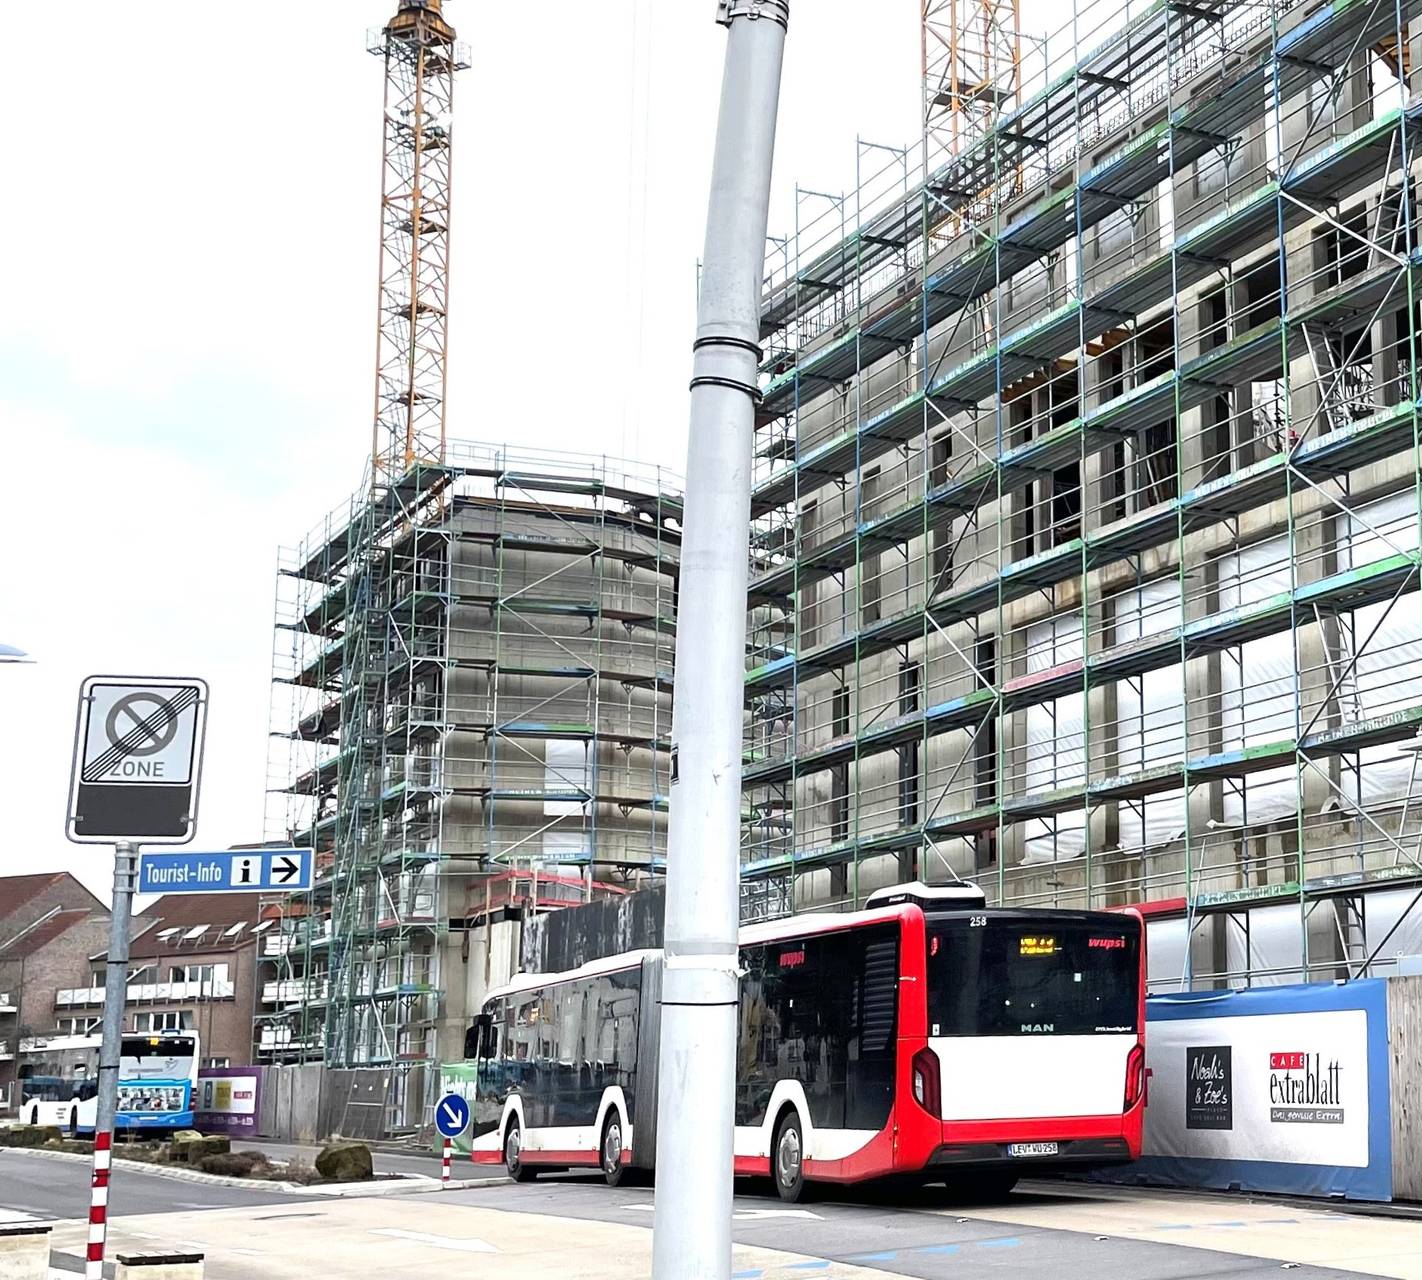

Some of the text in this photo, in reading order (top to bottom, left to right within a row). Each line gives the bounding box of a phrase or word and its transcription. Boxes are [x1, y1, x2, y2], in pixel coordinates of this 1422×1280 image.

[109, 761, 165, 777] ZONE
[146, 861, 222, 884] Tourist-Info
[969, 916, 987, 927] 258
[1088, 935, 1126, 949] wupsi
[1020, 1023, 1055, 1033] MAN
[1191, 1053, 1225, 1080] Noah's
[1270, 1053, 1344, 1105] extrablatt
